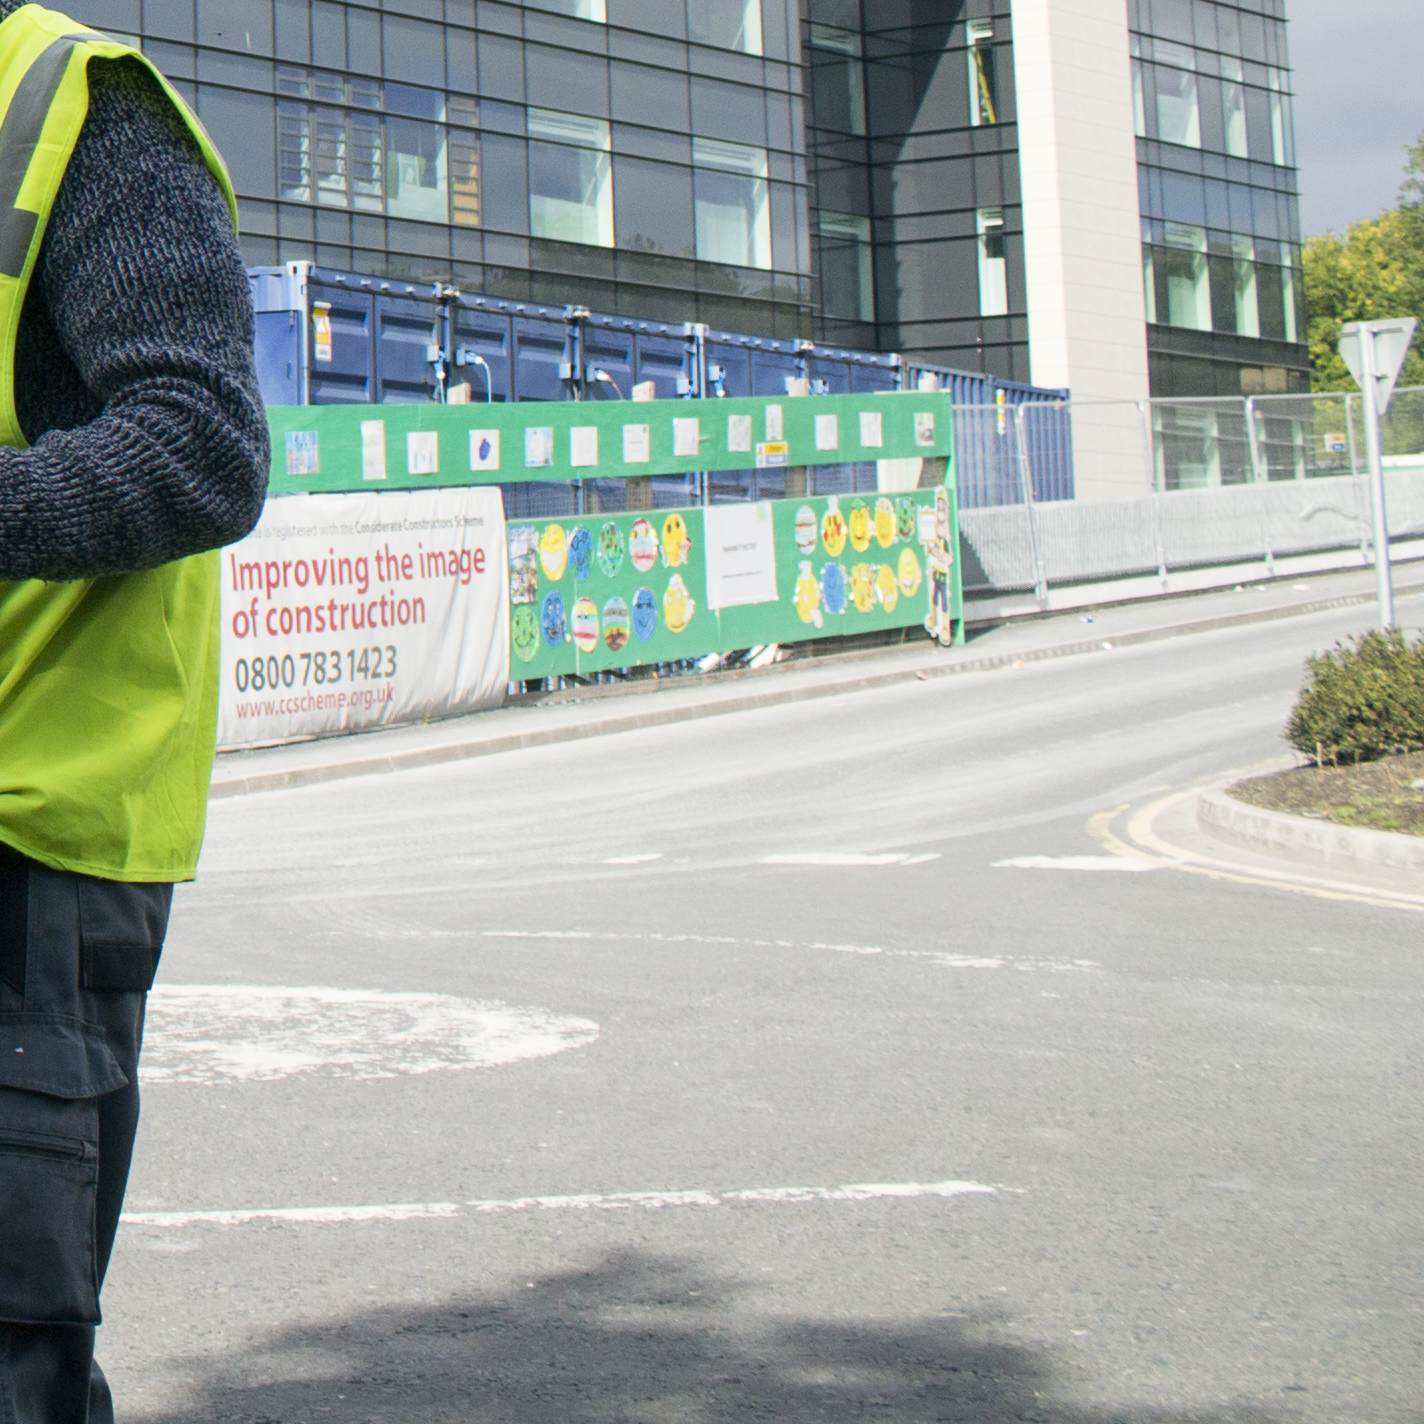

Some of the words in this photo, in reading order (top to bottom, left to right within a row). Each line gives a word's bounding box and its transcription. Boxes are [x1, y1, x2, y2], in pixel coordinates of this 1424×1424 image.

[355, 519, 402, 534] Considerate
[230, 548, 369, 600] Improving
[375, 543, 414, 583] the
[418, 542, 486, 586] image
[232, 597, 258, 639] of
[265, 589, 426, 637] construction
[235, 654, 295, 693] 0800
[299, 650, 342, 686] 783
[347, 644, 398, 682] 1423
[236, 682, 394, 719] www.ccscheme.org.uk
